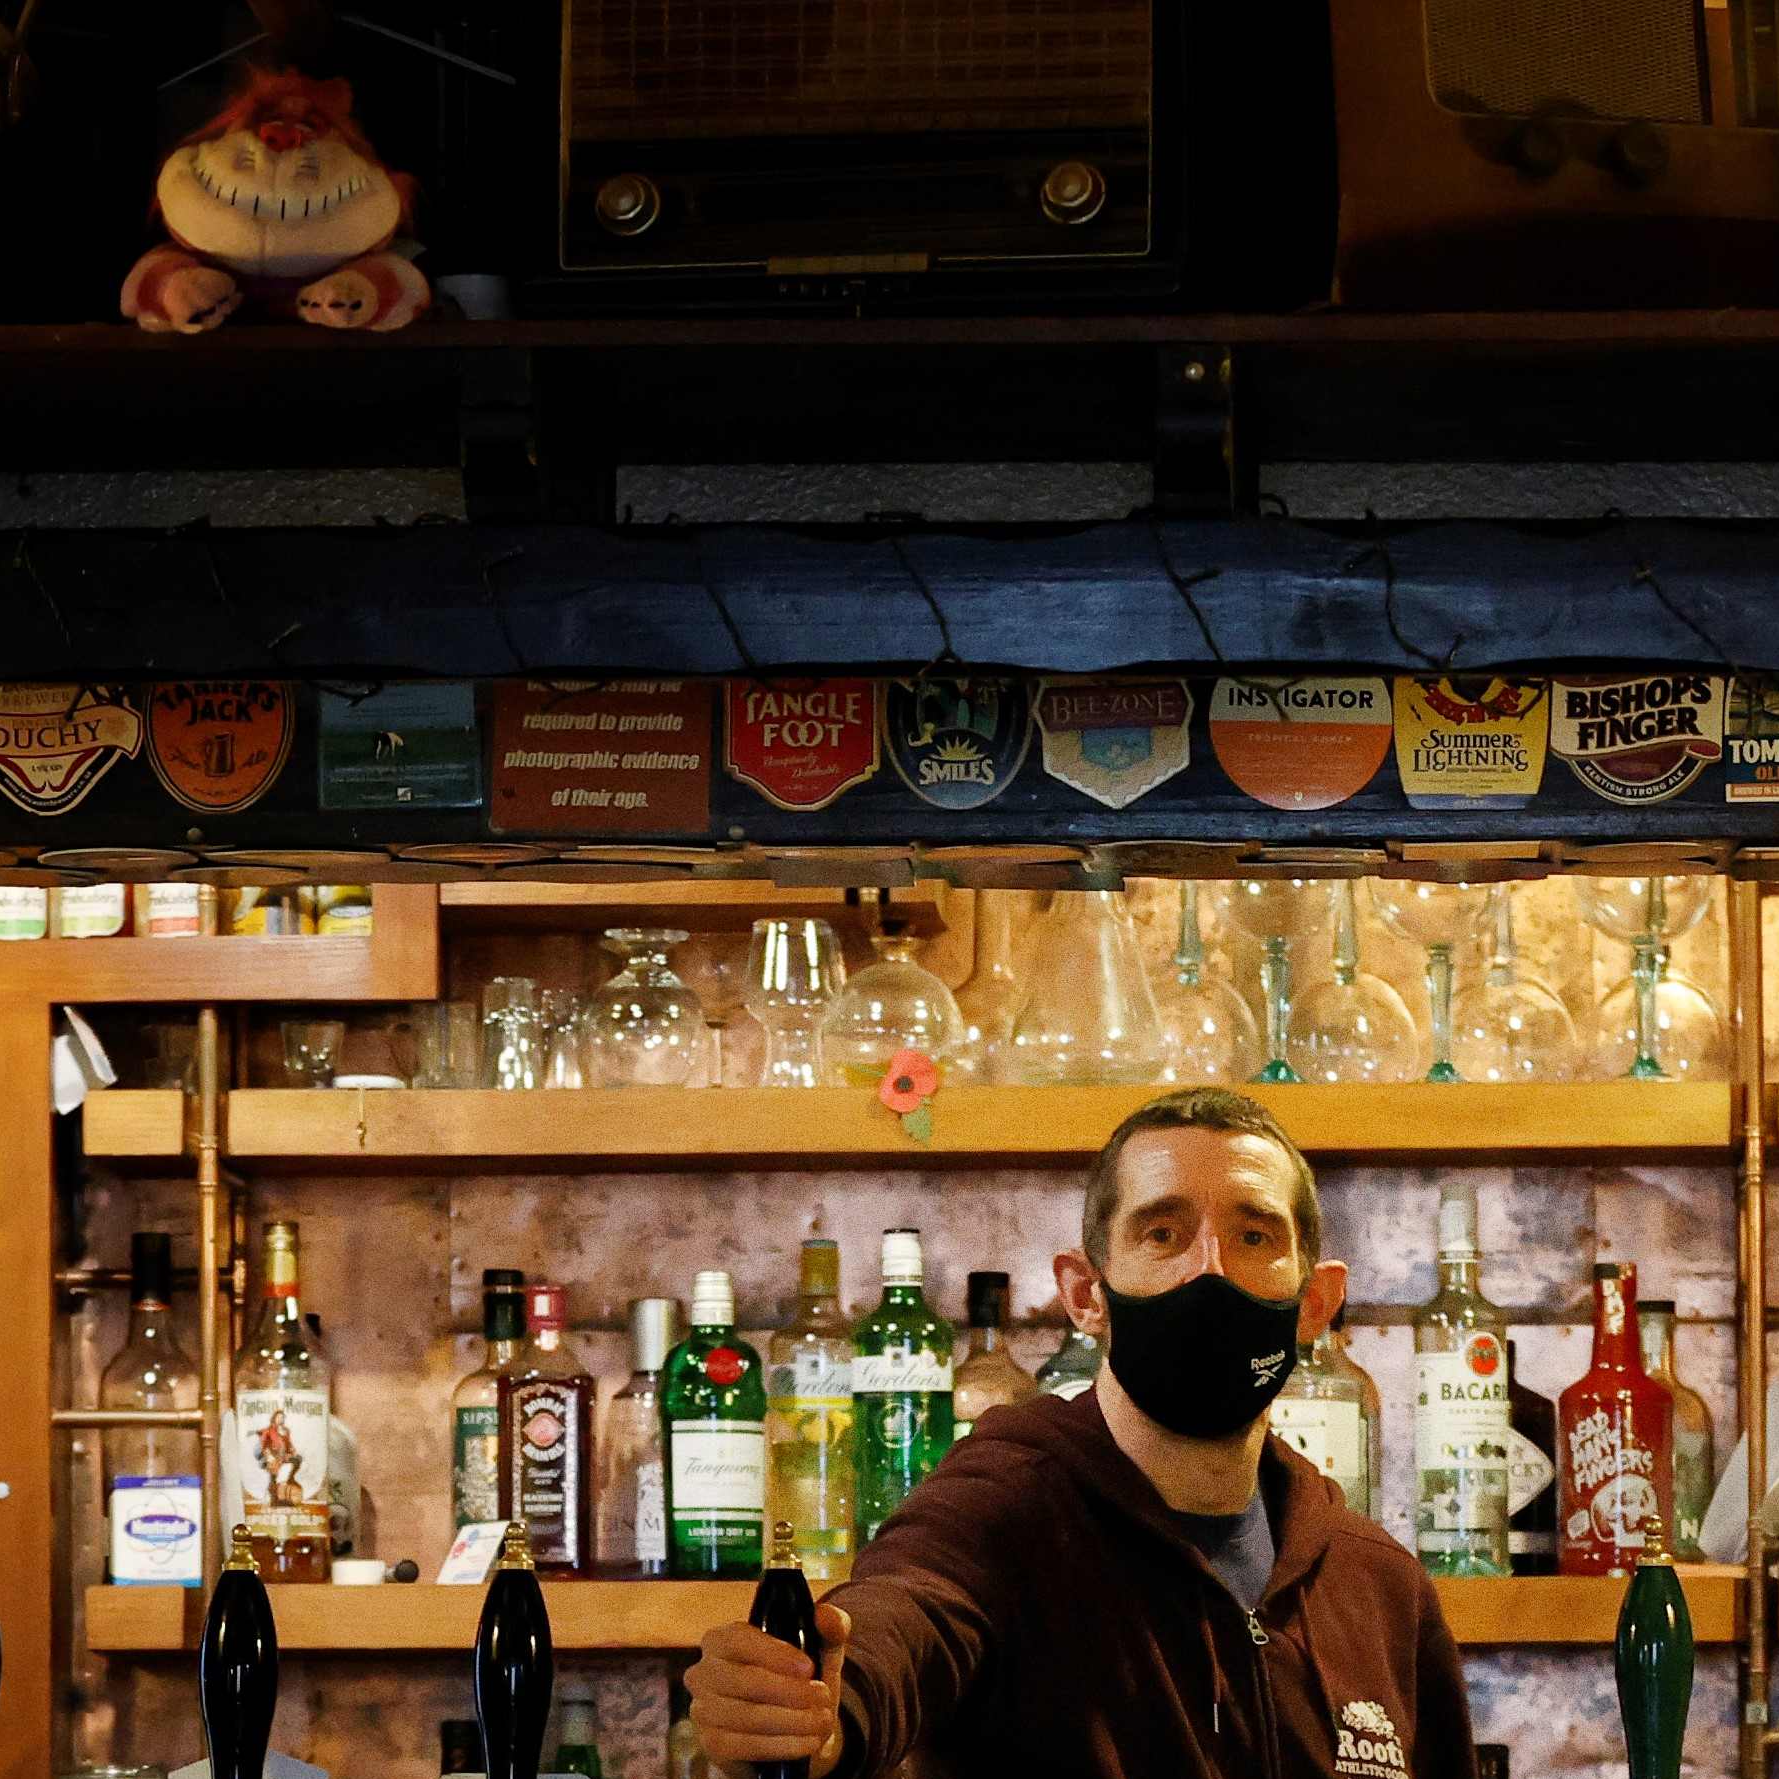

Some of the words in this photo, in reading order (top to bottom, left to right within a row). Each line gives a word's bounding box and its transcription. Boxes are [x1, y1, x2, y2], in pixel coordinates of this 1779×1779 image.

[187, 700, 252, 726] JACK
[745, 692, 862, 725] TANGLE
[523, 713, 598, 732] required
[599, 713, 617, 731] to
[619, 712, 684, 732] provide
[1577, 706, 1703, 751] FINGER
[763, 724, 844, 748] FOOT
[1420, 729, 1522, 750] Summer
[503, 751, 618, 771] photographic
[621, 752, 700, 771] evidence
[918, 758, 996, 787] SMILES
[1583, 765, 1623, 796] KENTISH
[1623, 782, 1668, 798] STRONG
[1668, 769, 1687, 787] ALE
[551, 789, 570, 807] of
[571, 789, 612, 807] their
[613, 790, 649, 809] age.
[1250, 1350, 1286, 1371] Reebok
[283, 1397, 324, 1417] Morgan
[461, 1411, 498, 1426] SIPS
[1570, 1408, 1610, 1444] DEAD
[1571, 1429, 1621, 1471] MANY
[683, 1455, 761, 1477] Tanqueray
[1573, 1449, 1653, 1493] FINGERS
